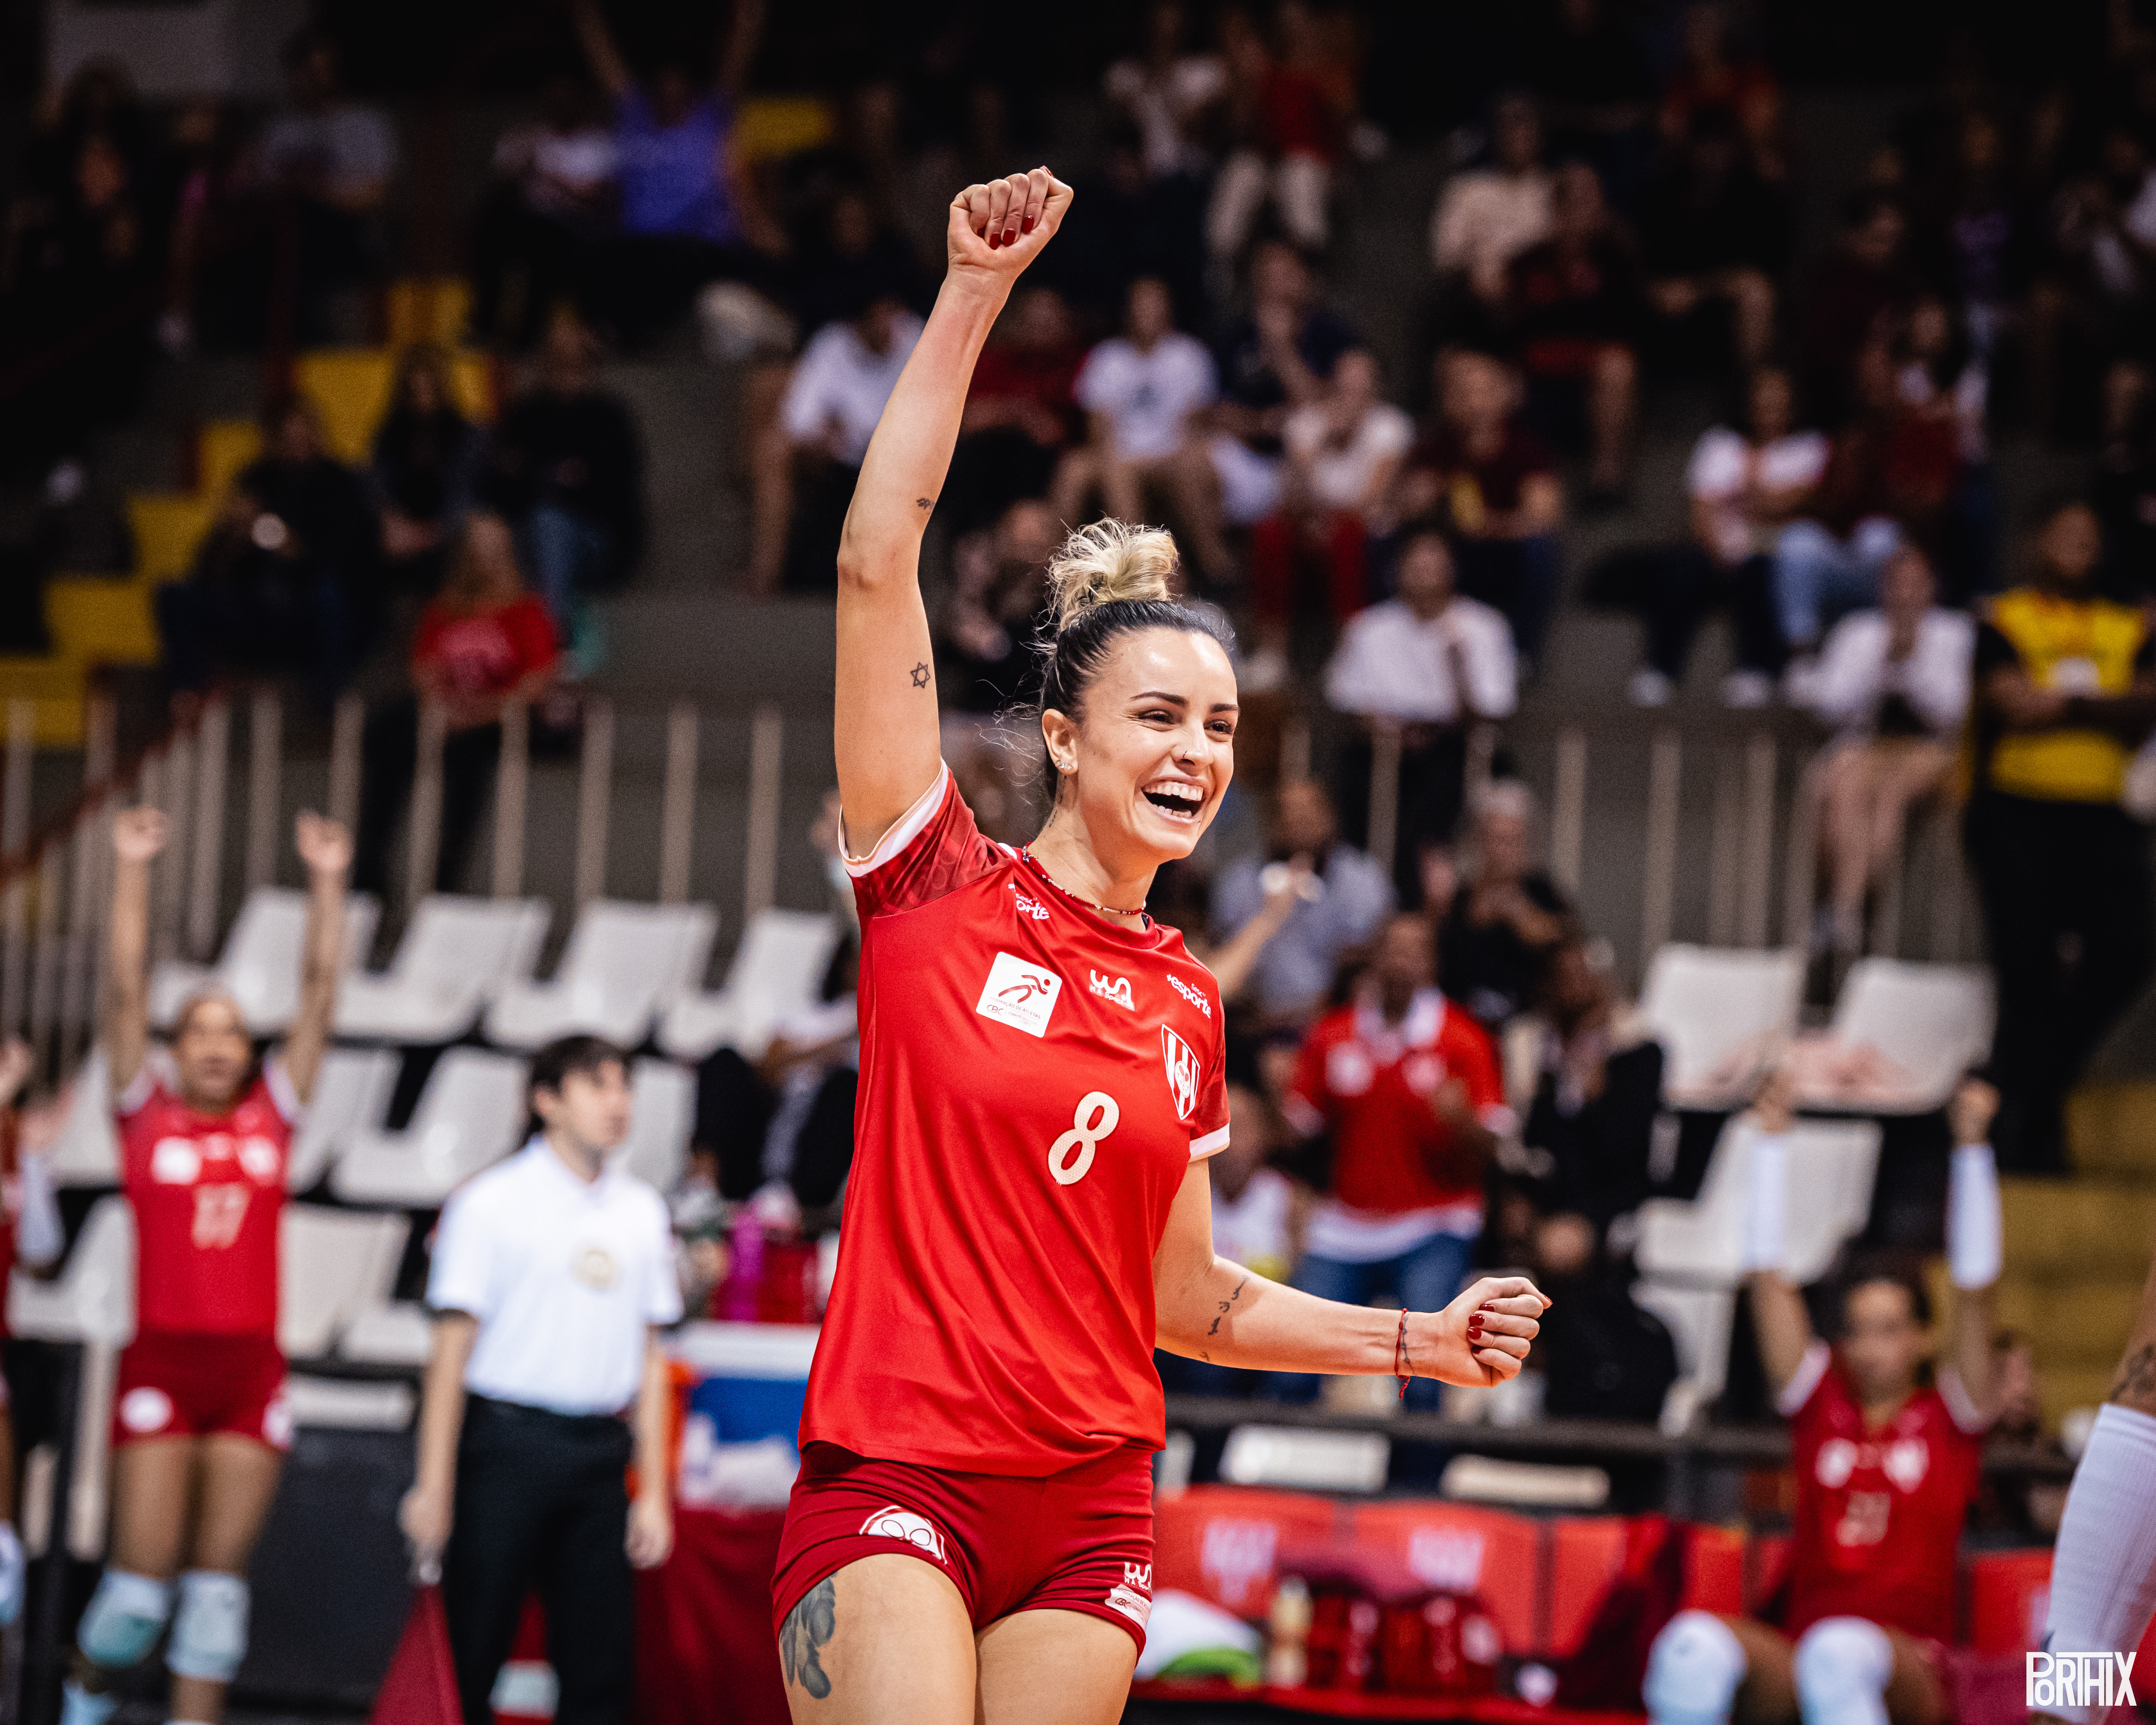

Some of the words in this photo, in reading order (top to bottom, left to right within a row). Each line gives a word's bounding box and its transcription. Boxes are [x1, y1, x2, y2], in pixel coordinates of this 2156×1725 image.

[990, 996, 1015, 1008] FORMAÇÃO
[1022, 1008, 1041, 1019] ATLETAS
[1048, 1091, 1119, 1185] 8
